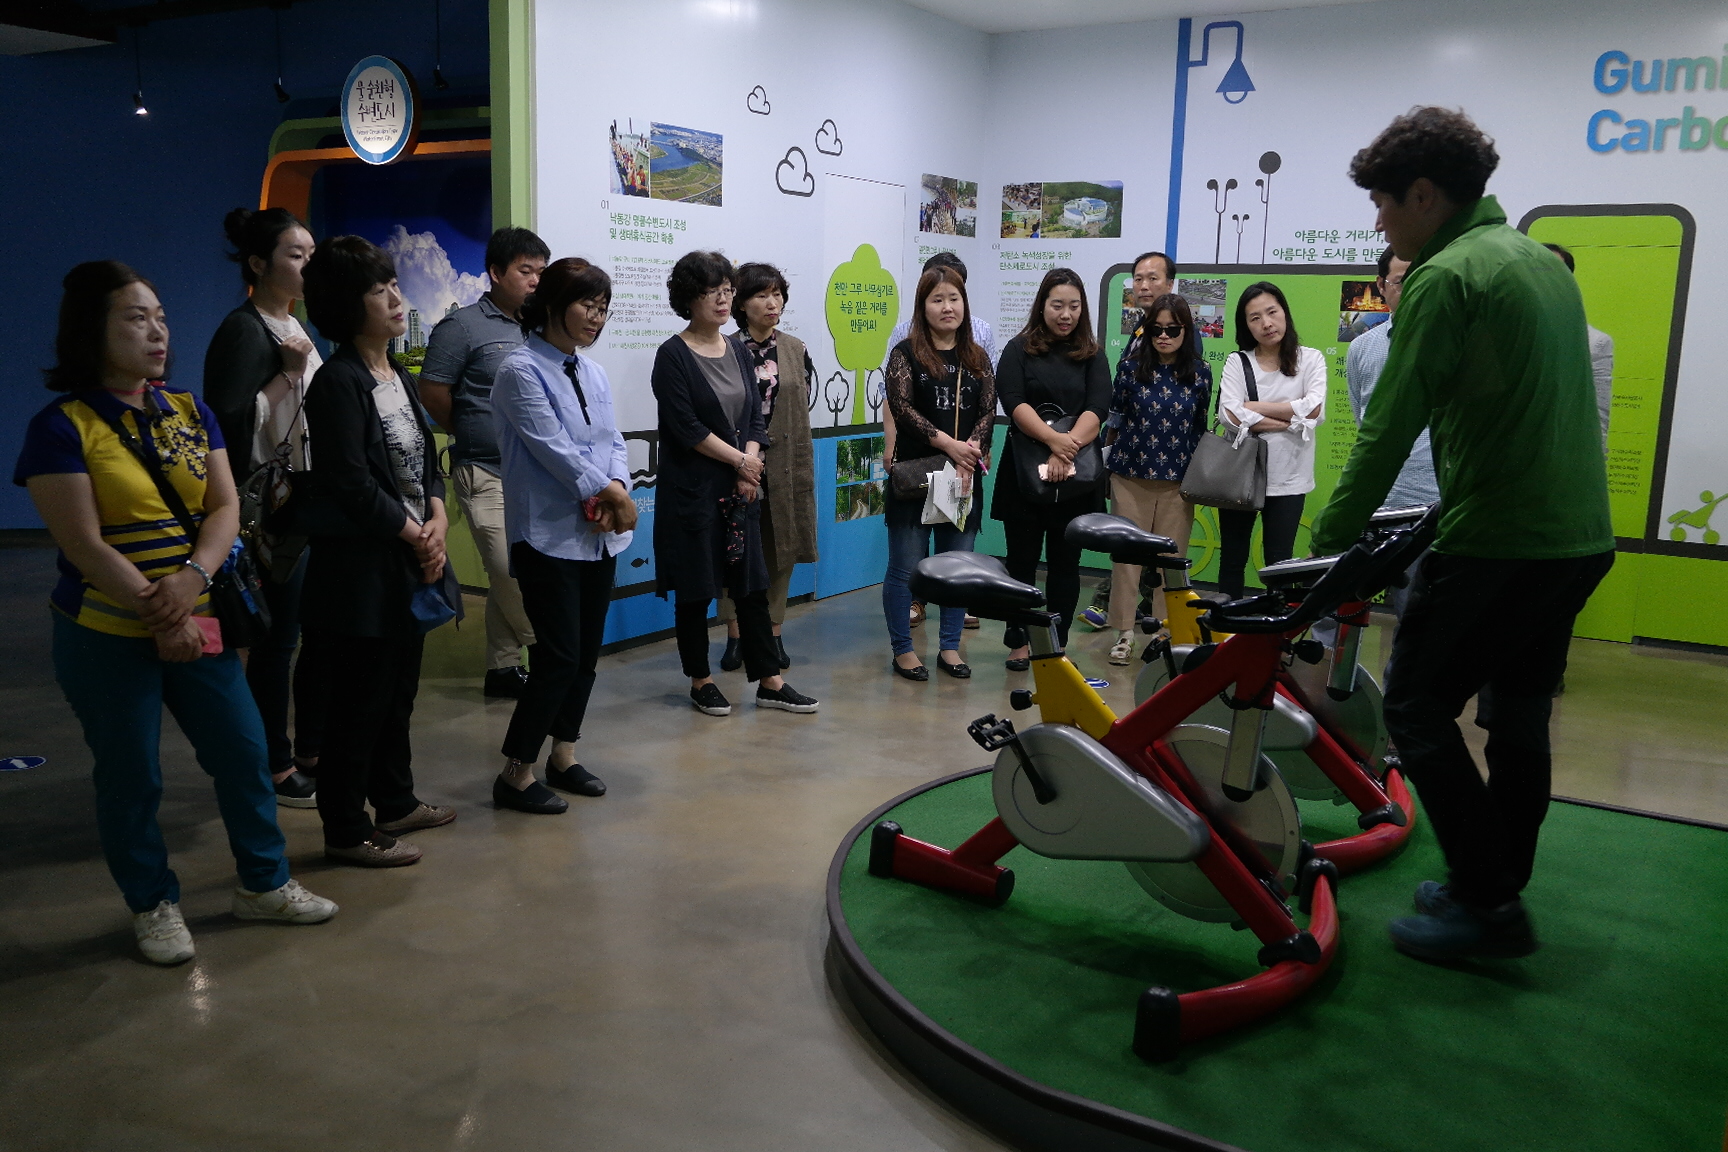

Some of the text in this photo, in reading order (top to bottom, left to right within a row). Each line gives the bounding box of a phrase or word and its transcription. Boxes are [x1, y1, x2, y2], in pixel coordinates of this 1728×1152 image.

[1594, 43, 1728, 94] Gumi
[358, 102, 395, 122] 수변도시
[601, 200, 610, 210] 01
[610, 212, 687, 231] 낙동강 명품수변도시 조성
[609, 227, 617, 240] 및
[619, 228, 660, 243] 생태휴식공간
[1294, 229, 1341, 244] 아름다운
[1272, 247, 1318, 262] 아름다운
[1322, 247, 1358, 262] 도시를
[834, 281, 894, 298] 천만 그루 나무심기로
[840, 300, 888, 316] 녹음 짙은 거리를
[850, 319, 877, 333] 만들어요!
[1208, 351, 1225, 361] 완성
[1326, 347, 1337, 355] 05
